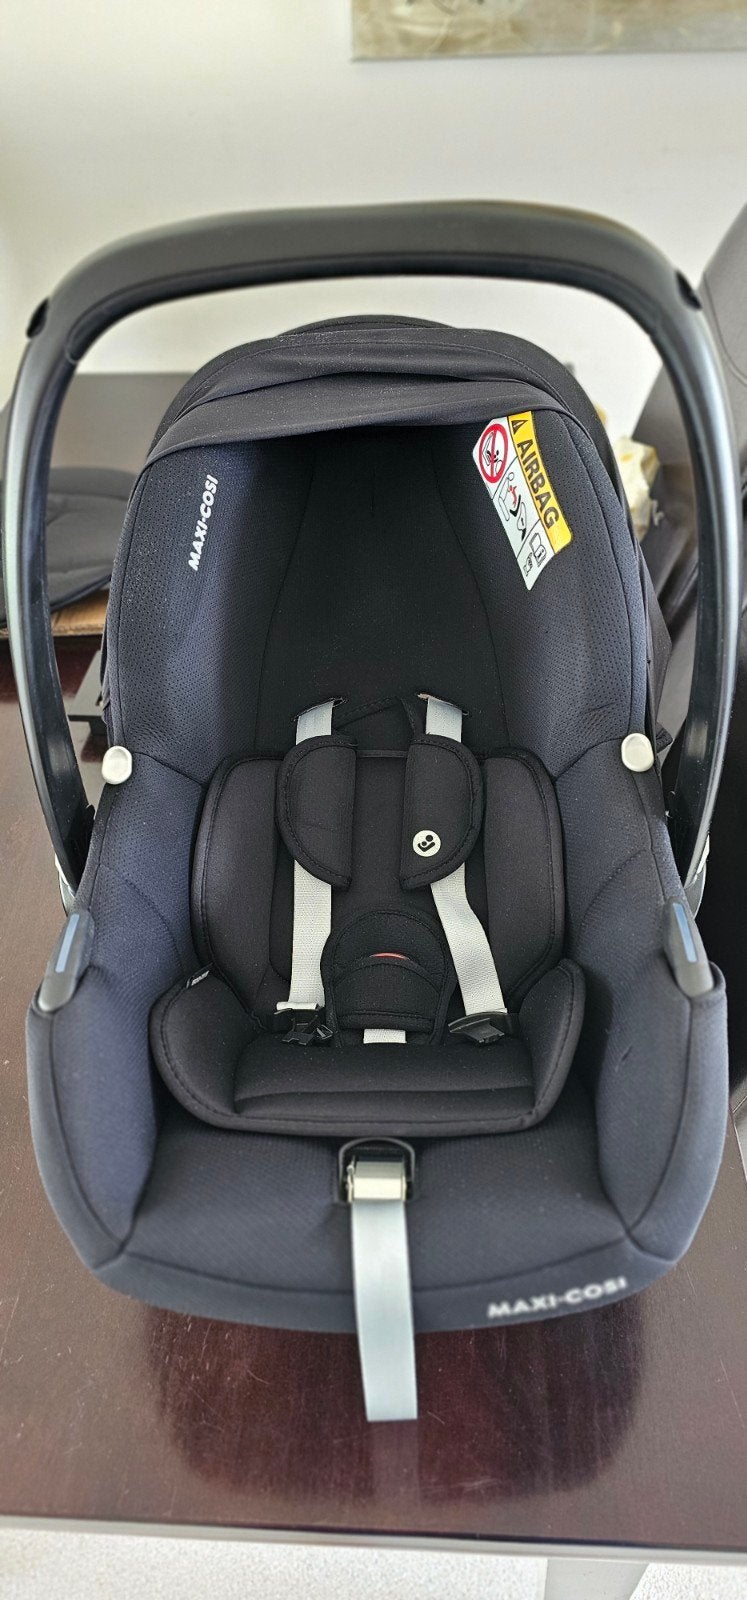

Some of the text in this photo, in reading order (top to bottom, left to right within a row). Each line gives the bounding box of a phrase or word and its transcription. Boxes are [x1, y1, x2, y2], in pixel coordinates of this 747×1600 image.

[188, 474, 218, 571] MAXI-COSI
[517, 439, 560, 529] AIRBAG
[488, 1276, 627, 1318] MAXI-COSI
